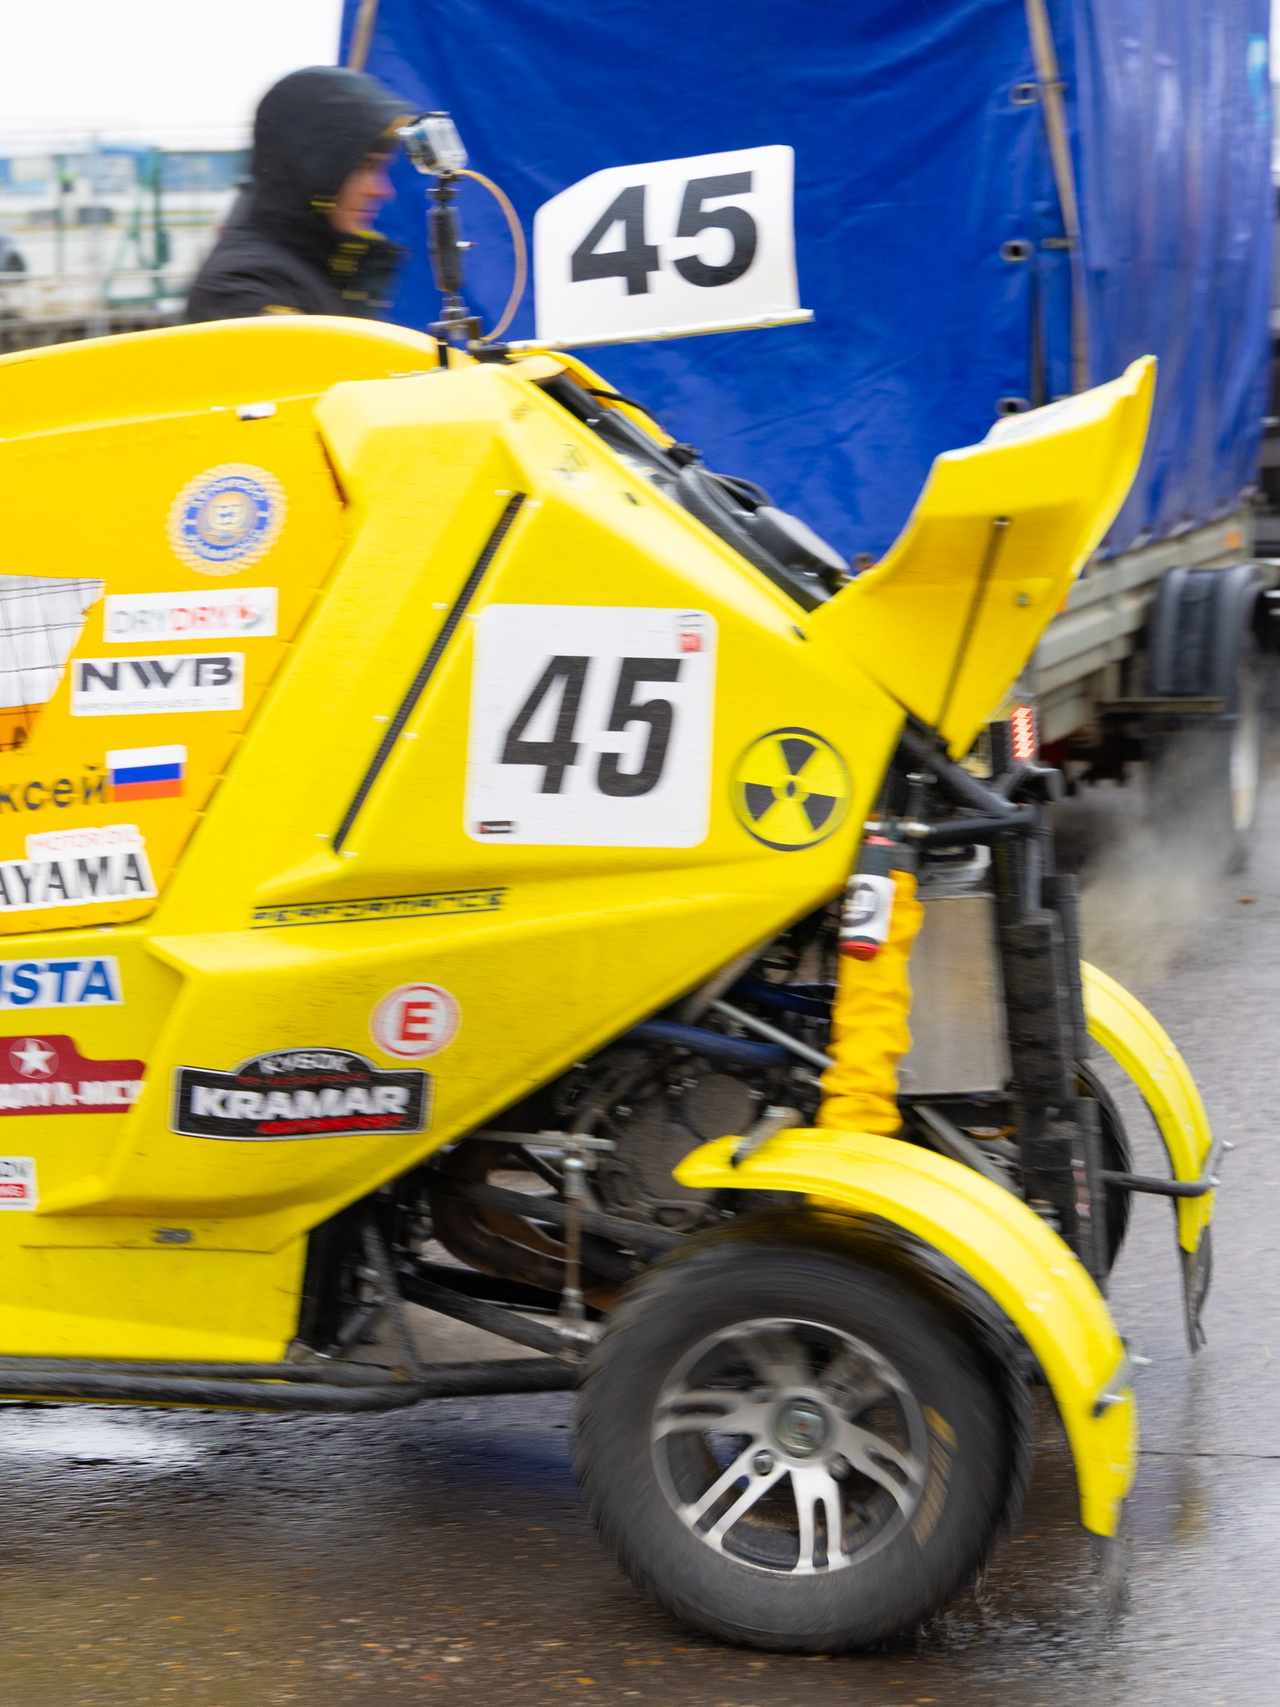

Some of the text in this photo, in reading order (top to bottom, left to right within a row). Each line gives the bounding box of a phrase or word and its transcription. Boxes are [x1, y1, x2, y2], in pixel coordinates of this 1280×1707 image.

[571, 170, 757, 295] 45
[79, 657, 233, 692] NWB
[501, 655, 683, 797] 45
[398, 1001, 436, 1042] E
[190, 1085, 410, 1120] KRAMAR
